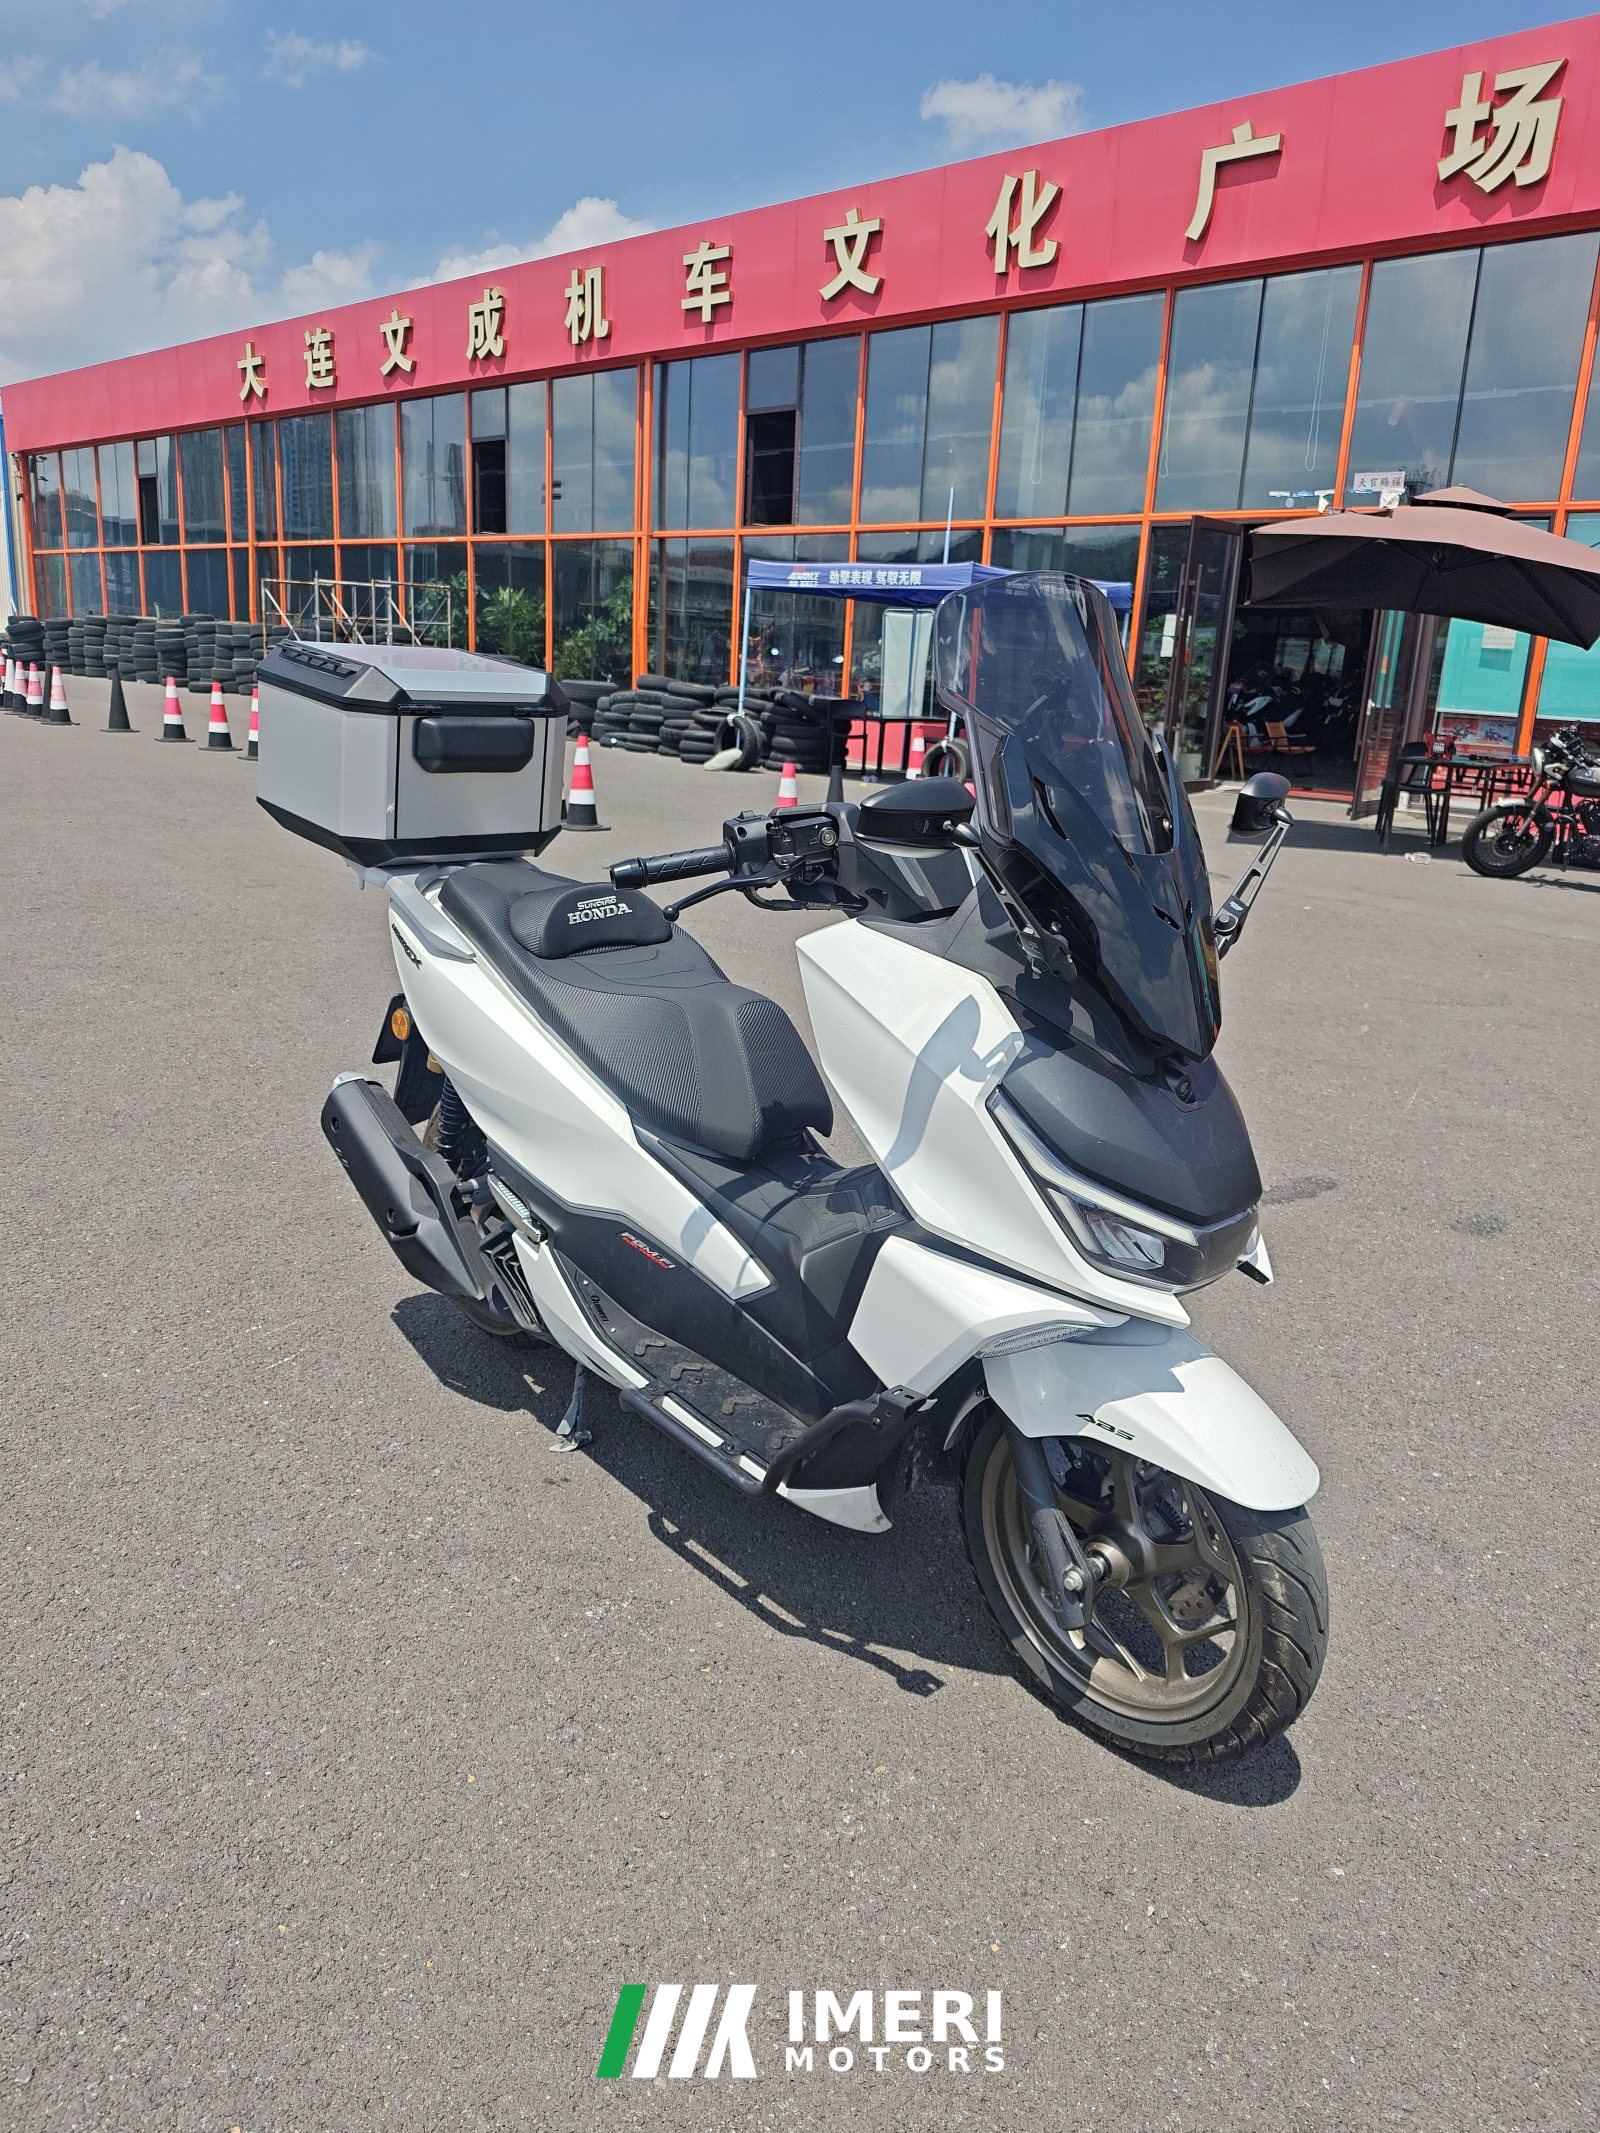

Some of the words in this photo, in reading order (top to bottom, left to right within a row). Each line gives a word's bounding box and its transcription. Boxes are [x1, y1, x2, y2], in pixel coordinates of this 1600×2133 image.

[236, 58, 1568, 401] 大连文成机车文化广场
[567, 903, 633, 925] HONDA
[1074, 1413, 1136, 1441] ABS
